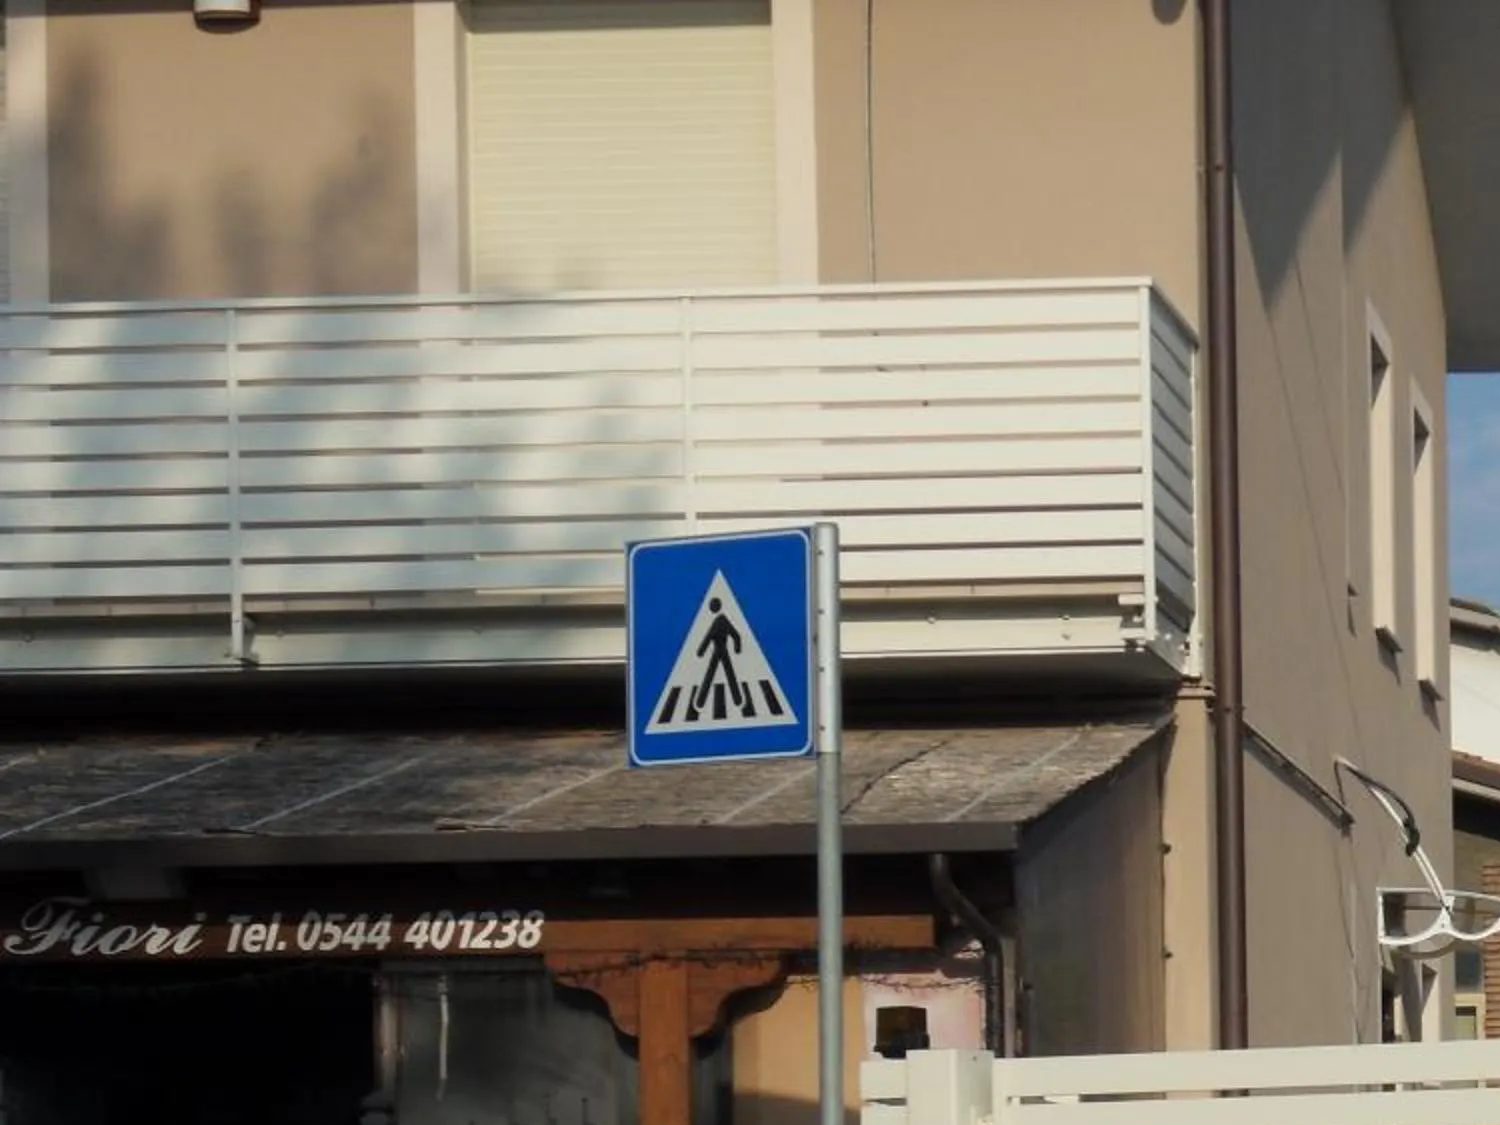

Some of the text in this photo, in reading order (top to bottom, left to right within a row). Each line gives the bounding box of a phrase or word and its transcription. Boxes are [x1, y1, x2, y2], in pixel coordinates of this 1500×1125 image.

[3, 897, 545, 956] Fiori Tel. 0544 401238
